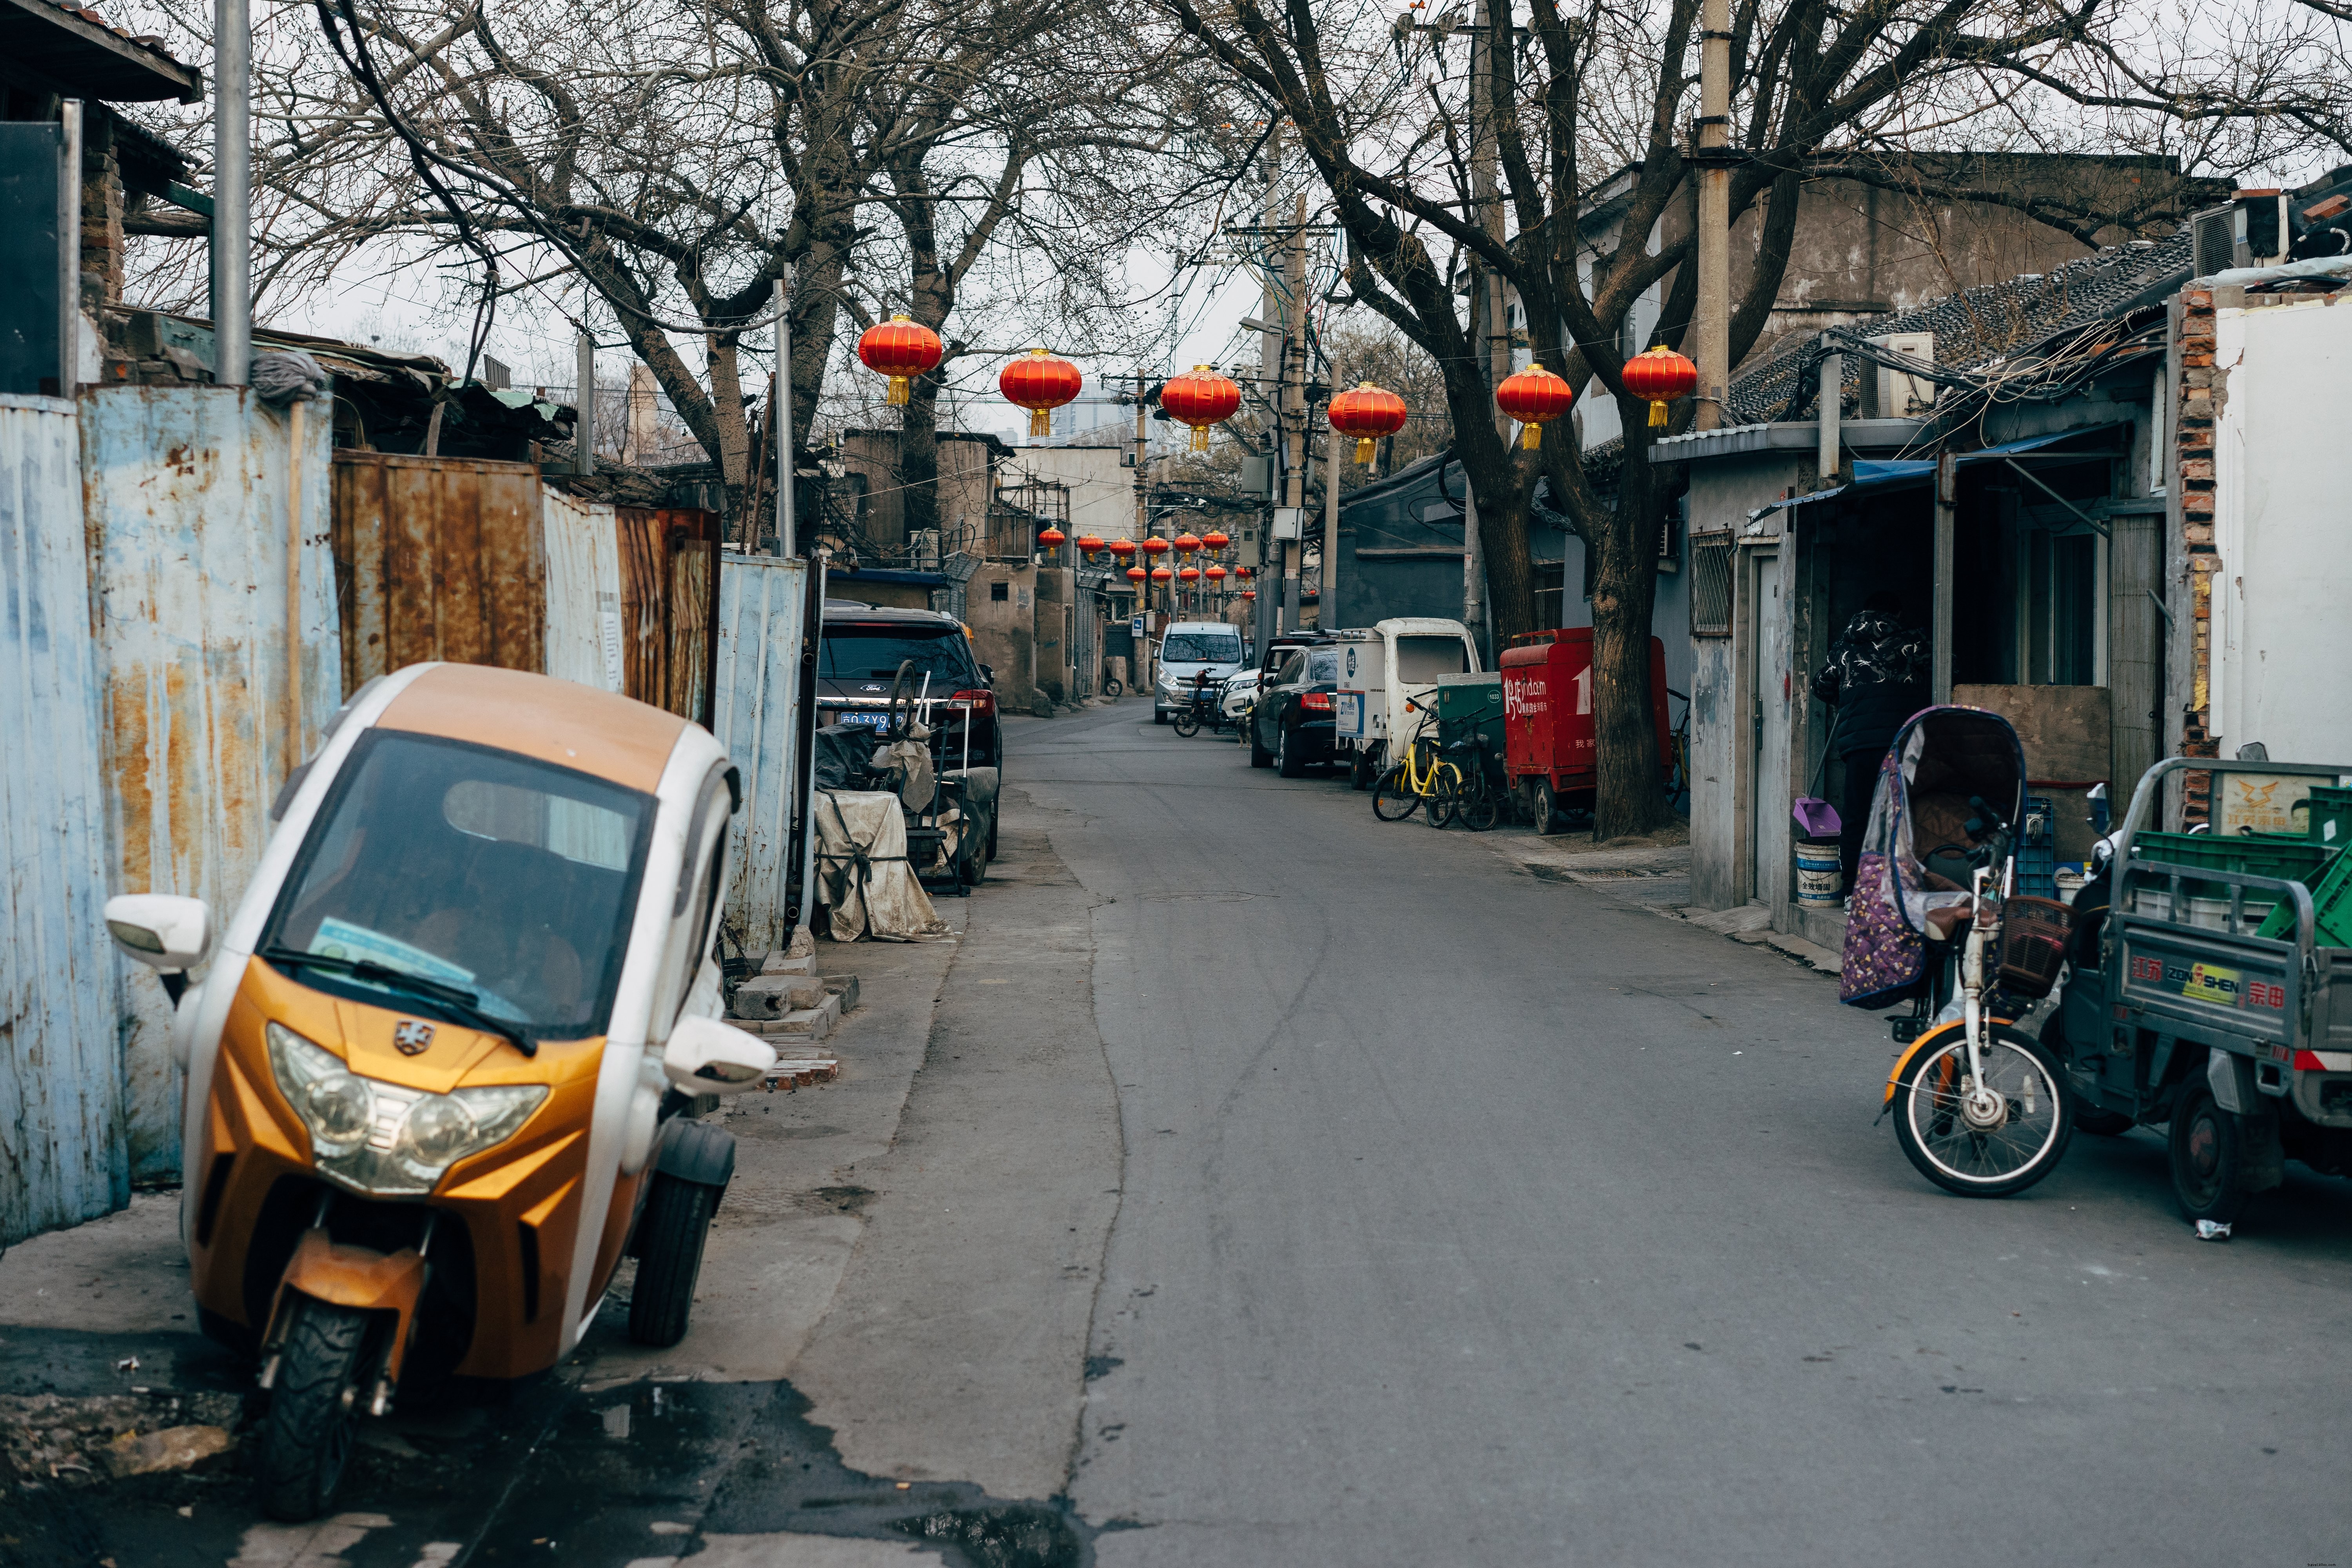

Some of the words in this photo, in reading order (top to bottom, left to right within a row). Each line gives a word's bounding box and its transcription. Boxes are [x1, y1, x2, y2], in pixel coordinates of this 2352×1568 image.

[1575, 739, 1595, 749] 我家
[1802, 882, 1831, 891] 全效墙固
[2132, 956, 2162, 981] 江苏
[2249, 981, 2285, 1009] 宗申
